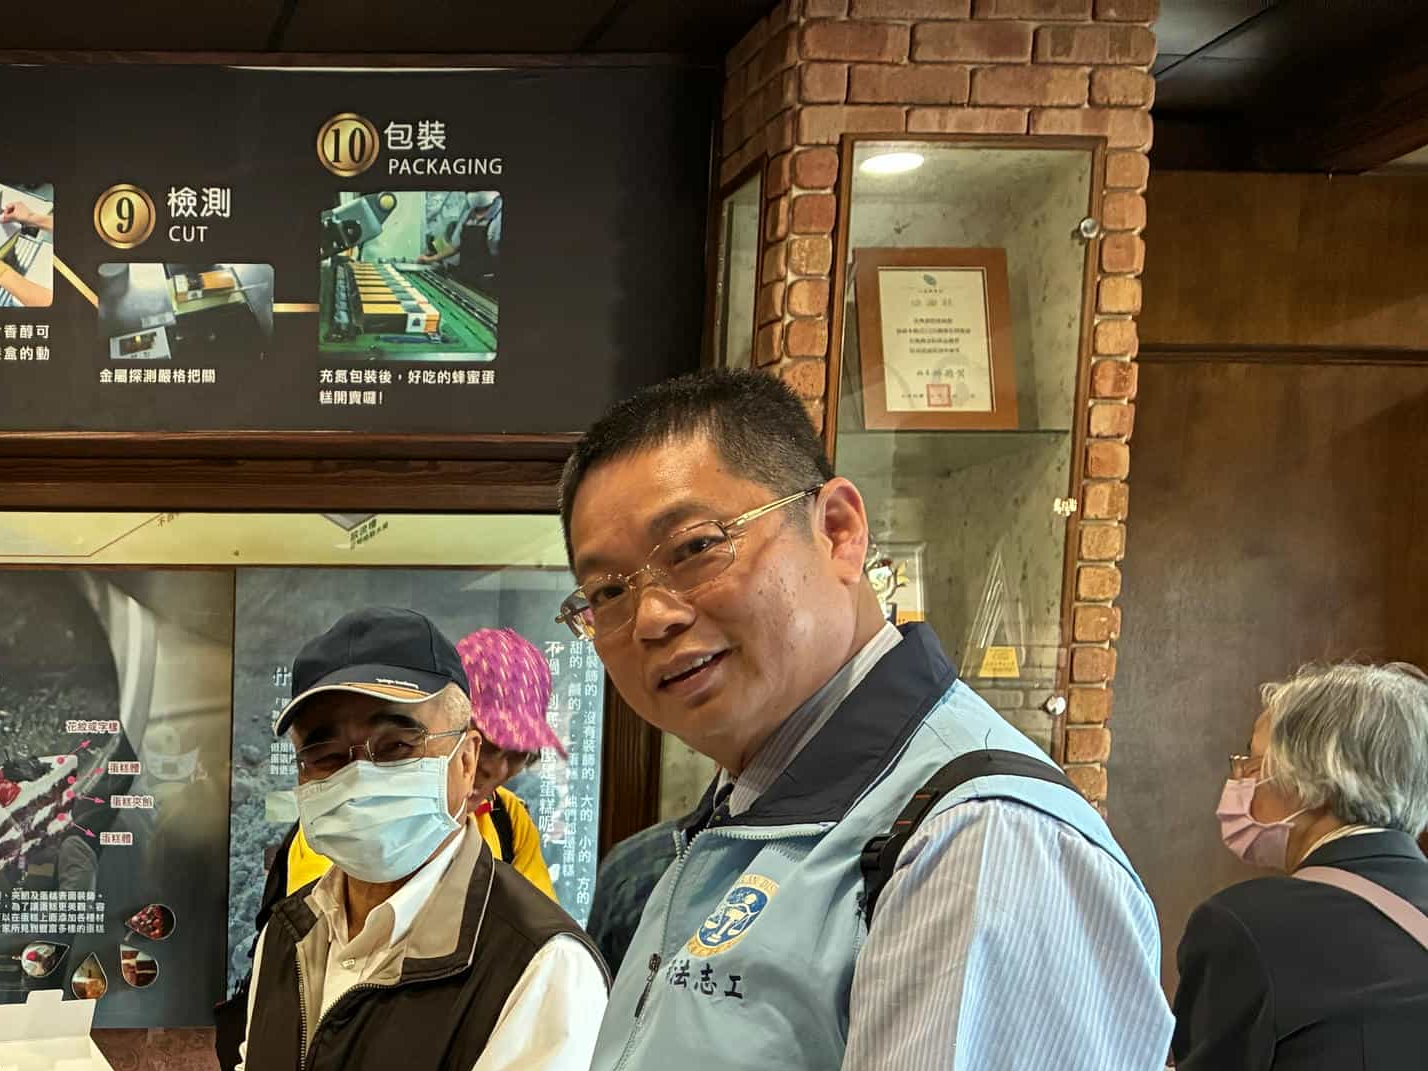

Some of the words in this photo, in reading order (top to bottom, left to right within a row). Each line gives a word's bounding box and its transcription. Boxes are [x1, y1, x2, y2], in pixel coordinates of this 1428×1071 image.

[331, 127, 367, 163] 10
[383, 120, 447, 151] 包裝
[388, 158, 503, 175] PACKAGING
[115, 196, 135, 234] 9
[167, 187, 231, 219] 檢測
[168, 226, 208, 242] CUT
